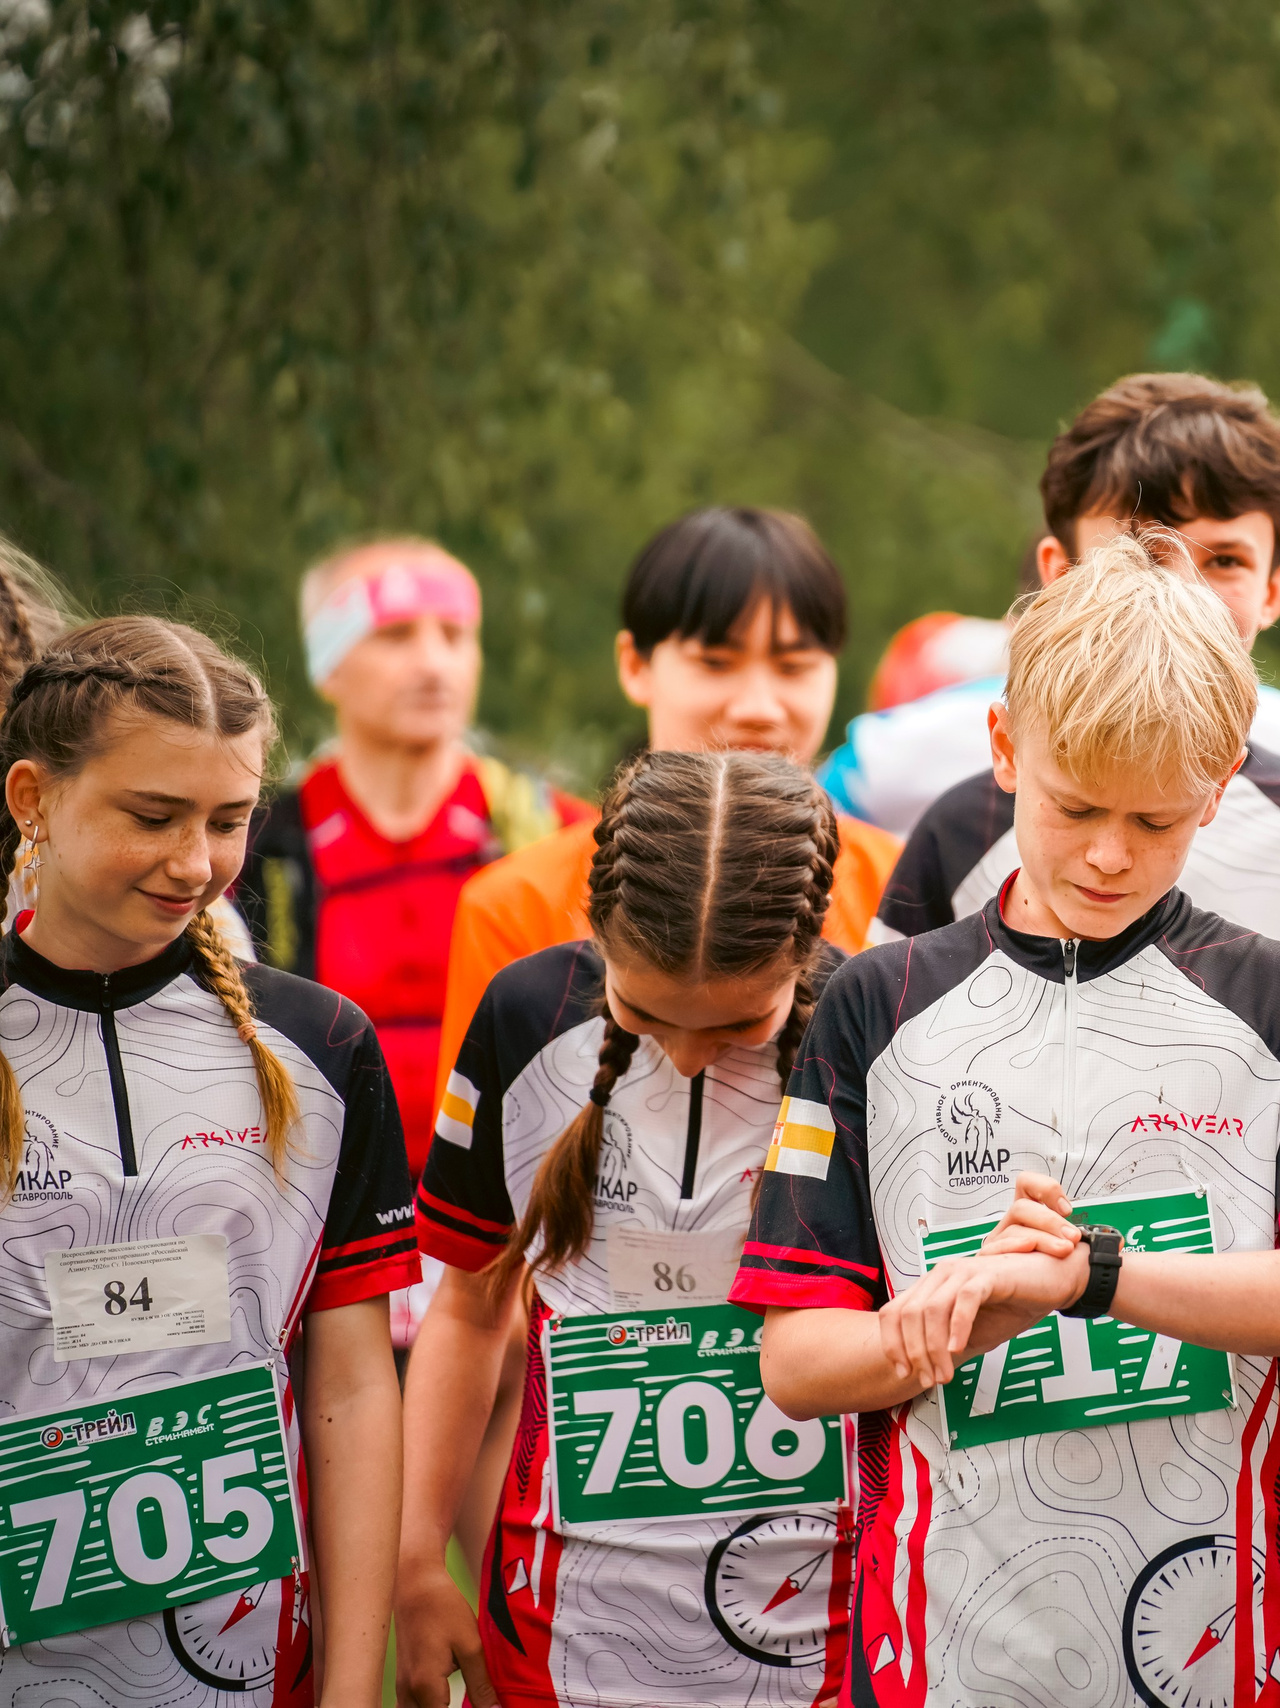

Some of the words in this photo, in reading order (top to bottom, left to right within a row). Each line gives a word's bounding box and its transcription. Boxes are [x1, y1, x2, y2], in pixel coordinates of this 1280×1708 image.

[936, 1094, 958, 1145] СПОРТИВНОЕ
[950, 1080, 1002, 1125] ОРИЕНТИРОВАНИЕ
[25, 1109, 59, 1149] НТИРОВАНИЕ
[181, 1126, 268, 1150] ARSWE
[947, 1149, 1010, 1175] ИКАР
[949, 1174, 1009, 1187] СТАВРОПОЛЬ
[12, 1191, 73, 1202] СТАВРОПОЛЬ
[653, 1262, 696, 1293] 86
[104, 1276, 153, 1316] 84
[145, 1423, 215, 1447] СТРИЖАМЕНТ
[573, 1381, 826, 1495] 706
[9, 1448, 274, 1611] 705
